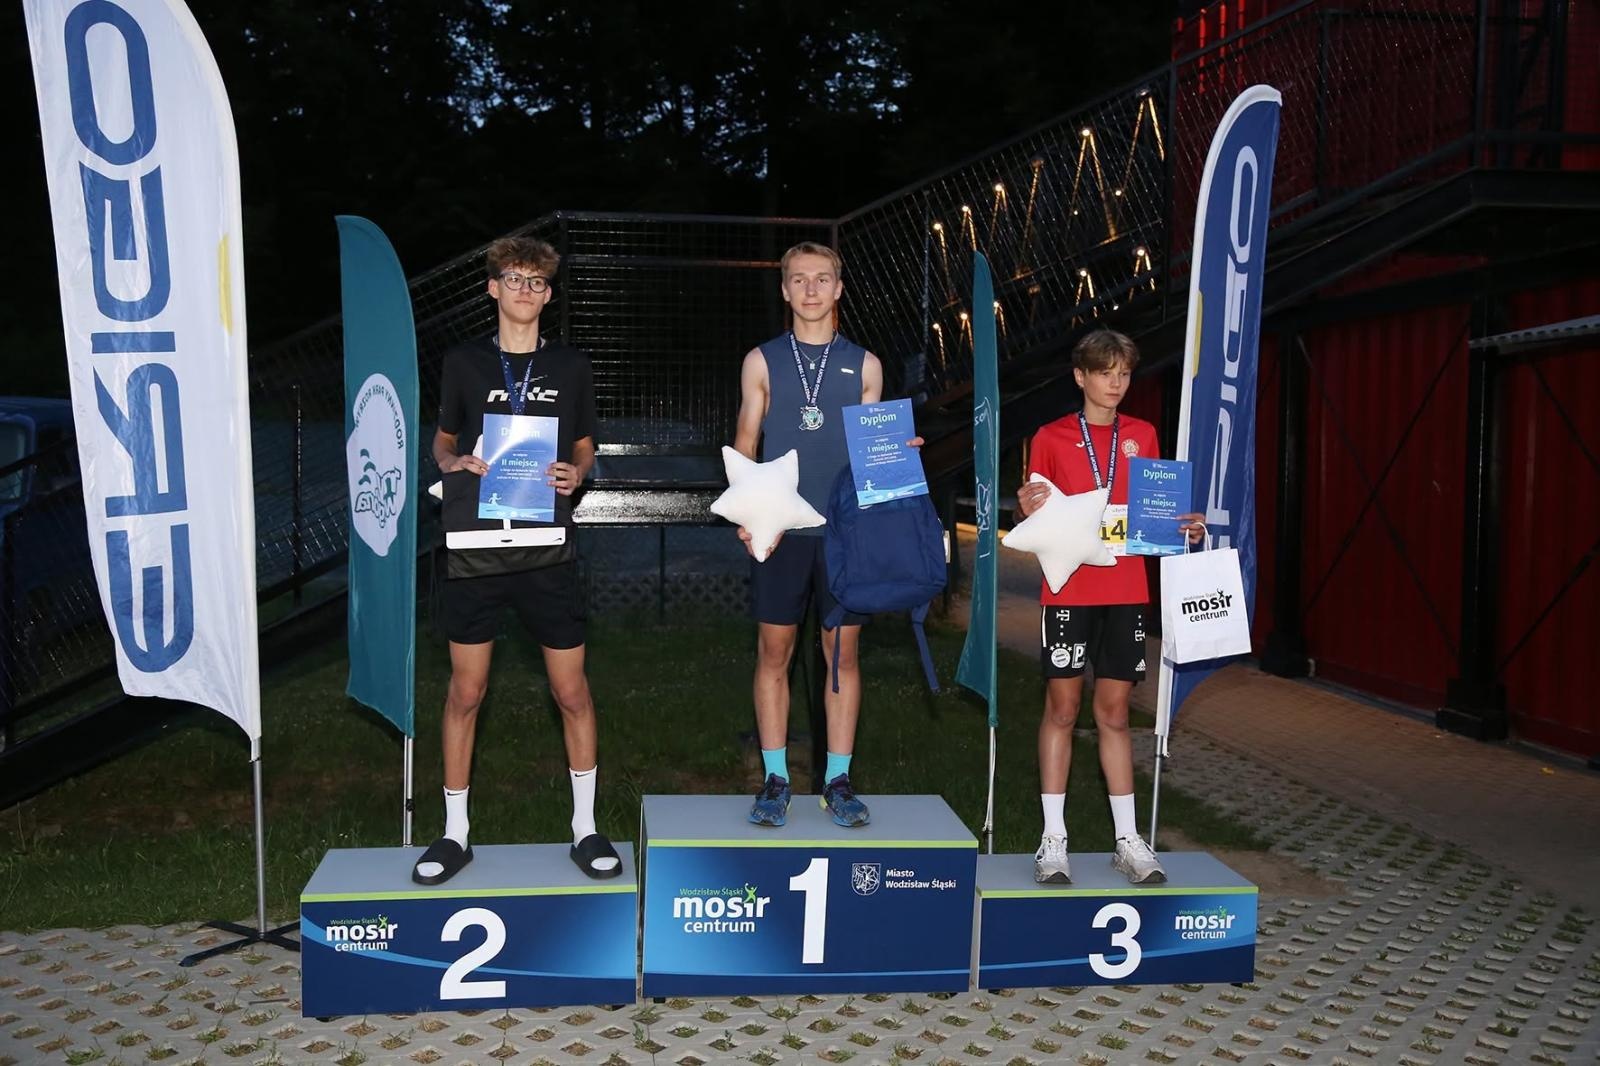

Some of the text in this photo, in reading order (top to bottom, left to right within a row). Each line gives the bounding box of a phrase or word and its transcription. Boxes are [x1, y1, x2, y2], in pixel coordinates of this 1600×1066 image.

[1205, 145, 1258, 549] RIGO
[860, 414, 896, 426] Dyplom
[872, 443, 898, 452] miejsca
[508, 459, 538, 467] miejsca
[1144, 469, 1176, 480] Dyplom
[1151, 498, 1176, 508] miejsca
[1182, 594, 1232, 614] mosir
[1190, 610, 1228, 622] centrum
[886, 868, 914, 877] Miasto
[885, 878, 956, 890] Wodzisław Śląski
[680, 887, 744, 896] Wodzisław Śląski
[673, 896, 770, 918] mosir
[789, 858, 829, 964] 1
[684, 920, 755, 933] centrum
[1175, 915, 1236, 930] mosir
[326, 924, 398, 941] mosir
[1181, 930, 1226, 940] centrum
[335, 941, 388, 952] centrum
[1088, 903, 1142, 979] 3
[440, 908, 506, 1000] 2
